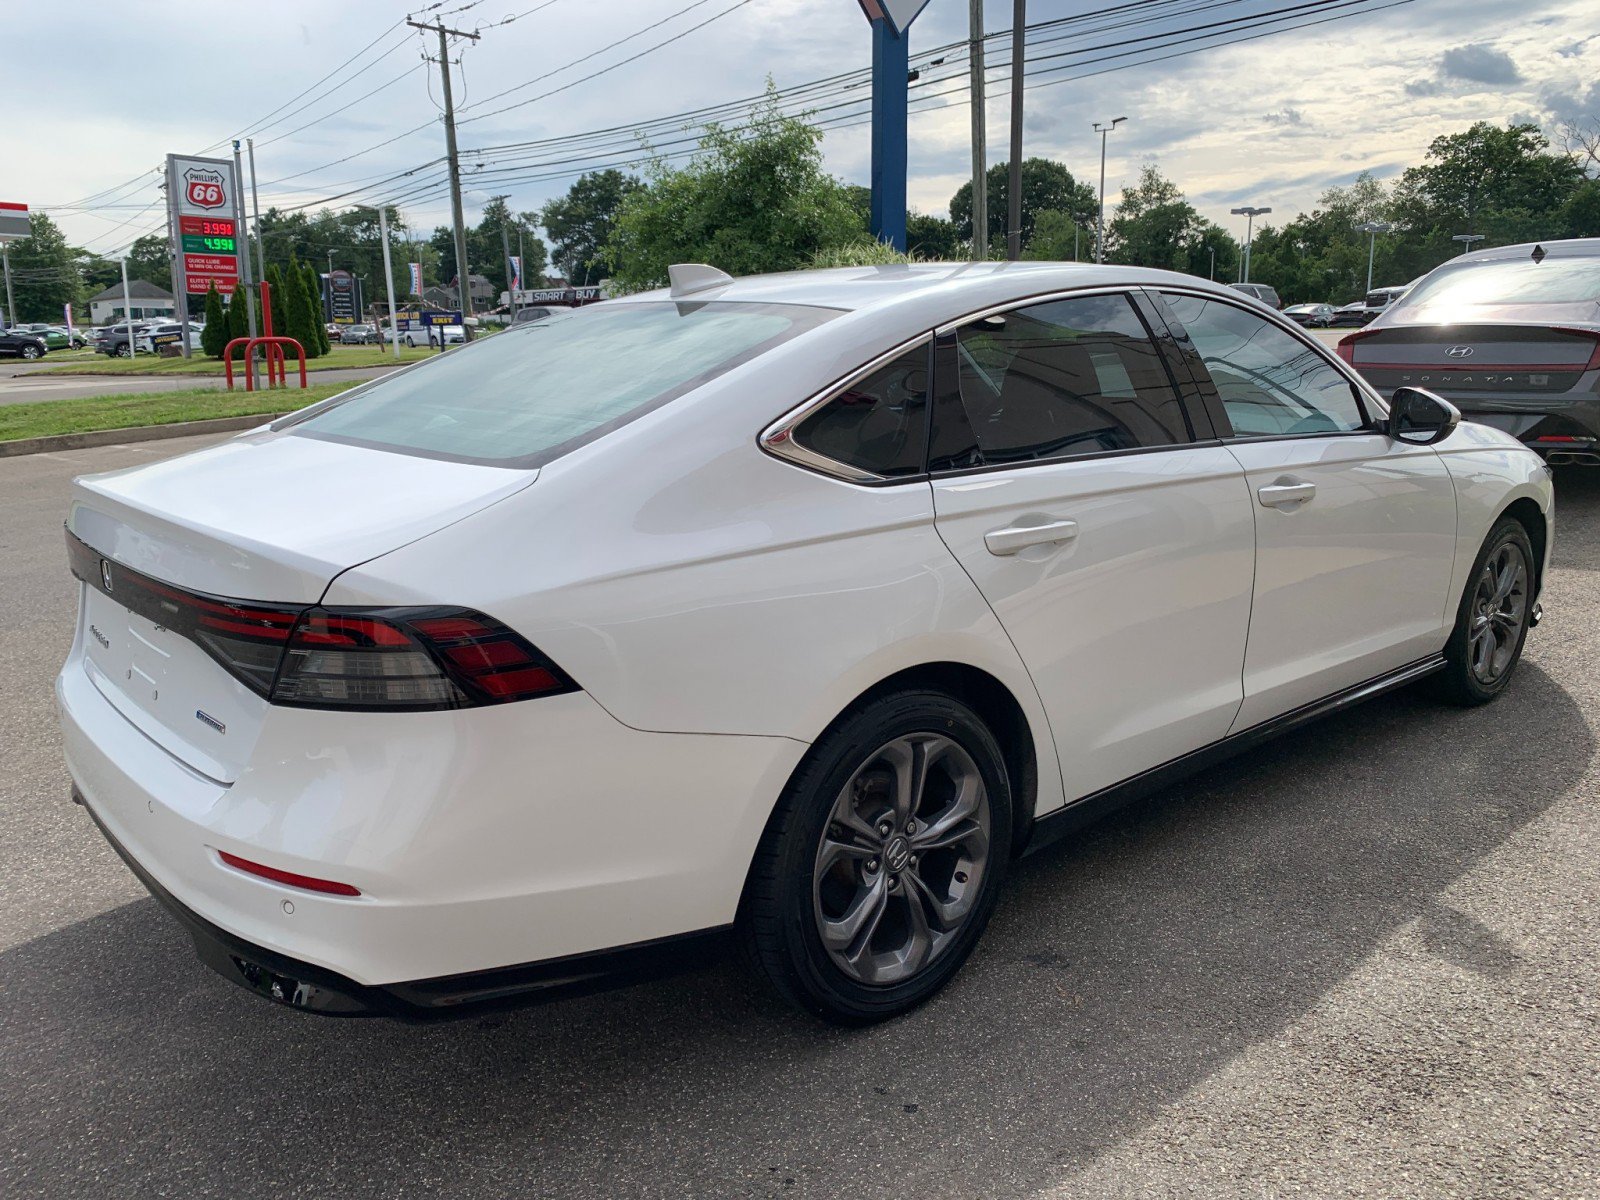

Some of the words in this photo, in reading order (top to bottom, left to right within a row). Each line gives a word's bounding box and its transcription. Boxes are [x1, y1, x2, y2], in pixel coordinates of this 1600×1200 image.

[190, 173, 219, 183] PHILLIPS
[193, 185, 218, 202] 66
[533, 291, 565, 302] SMART
[575, 289, 596, 299] BUY
[1401, 375, 1514, 383] SONATA
